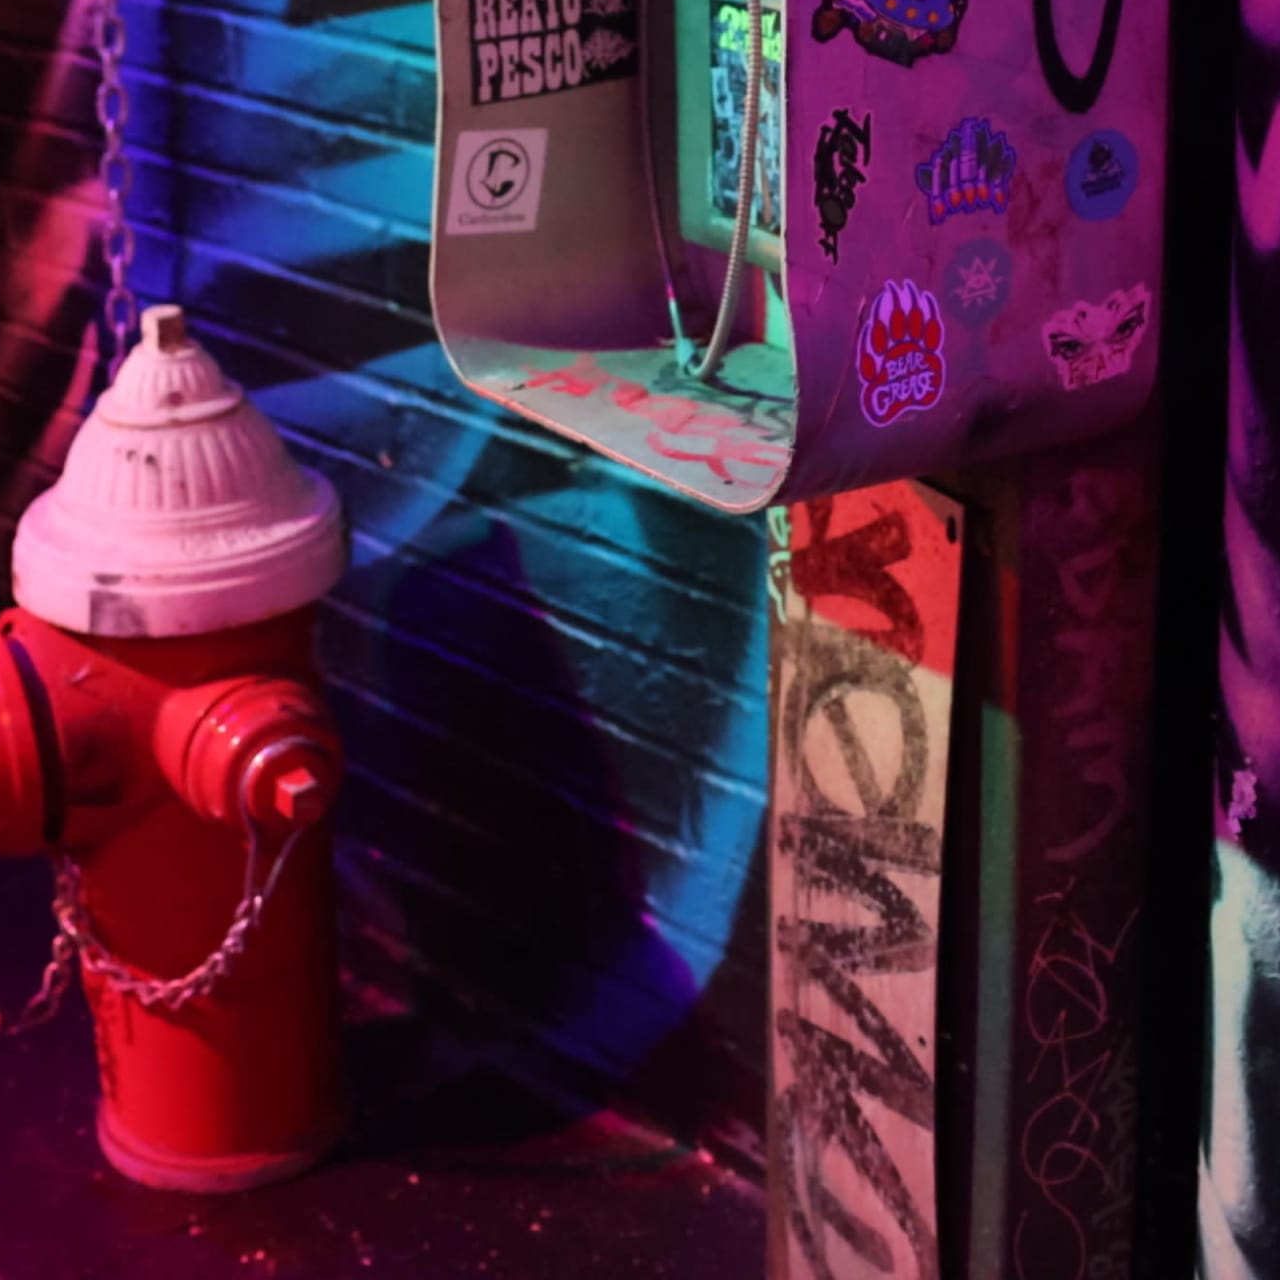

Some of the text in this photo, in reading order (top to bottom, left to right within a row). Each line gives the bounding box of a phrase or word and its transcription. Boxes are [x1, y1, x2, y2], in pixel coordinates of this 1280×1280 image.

[477, 28, 584, 103] PESCO
[886, 351, 930, 380] BEAR
[871, 371, 935, 417] GREASE
